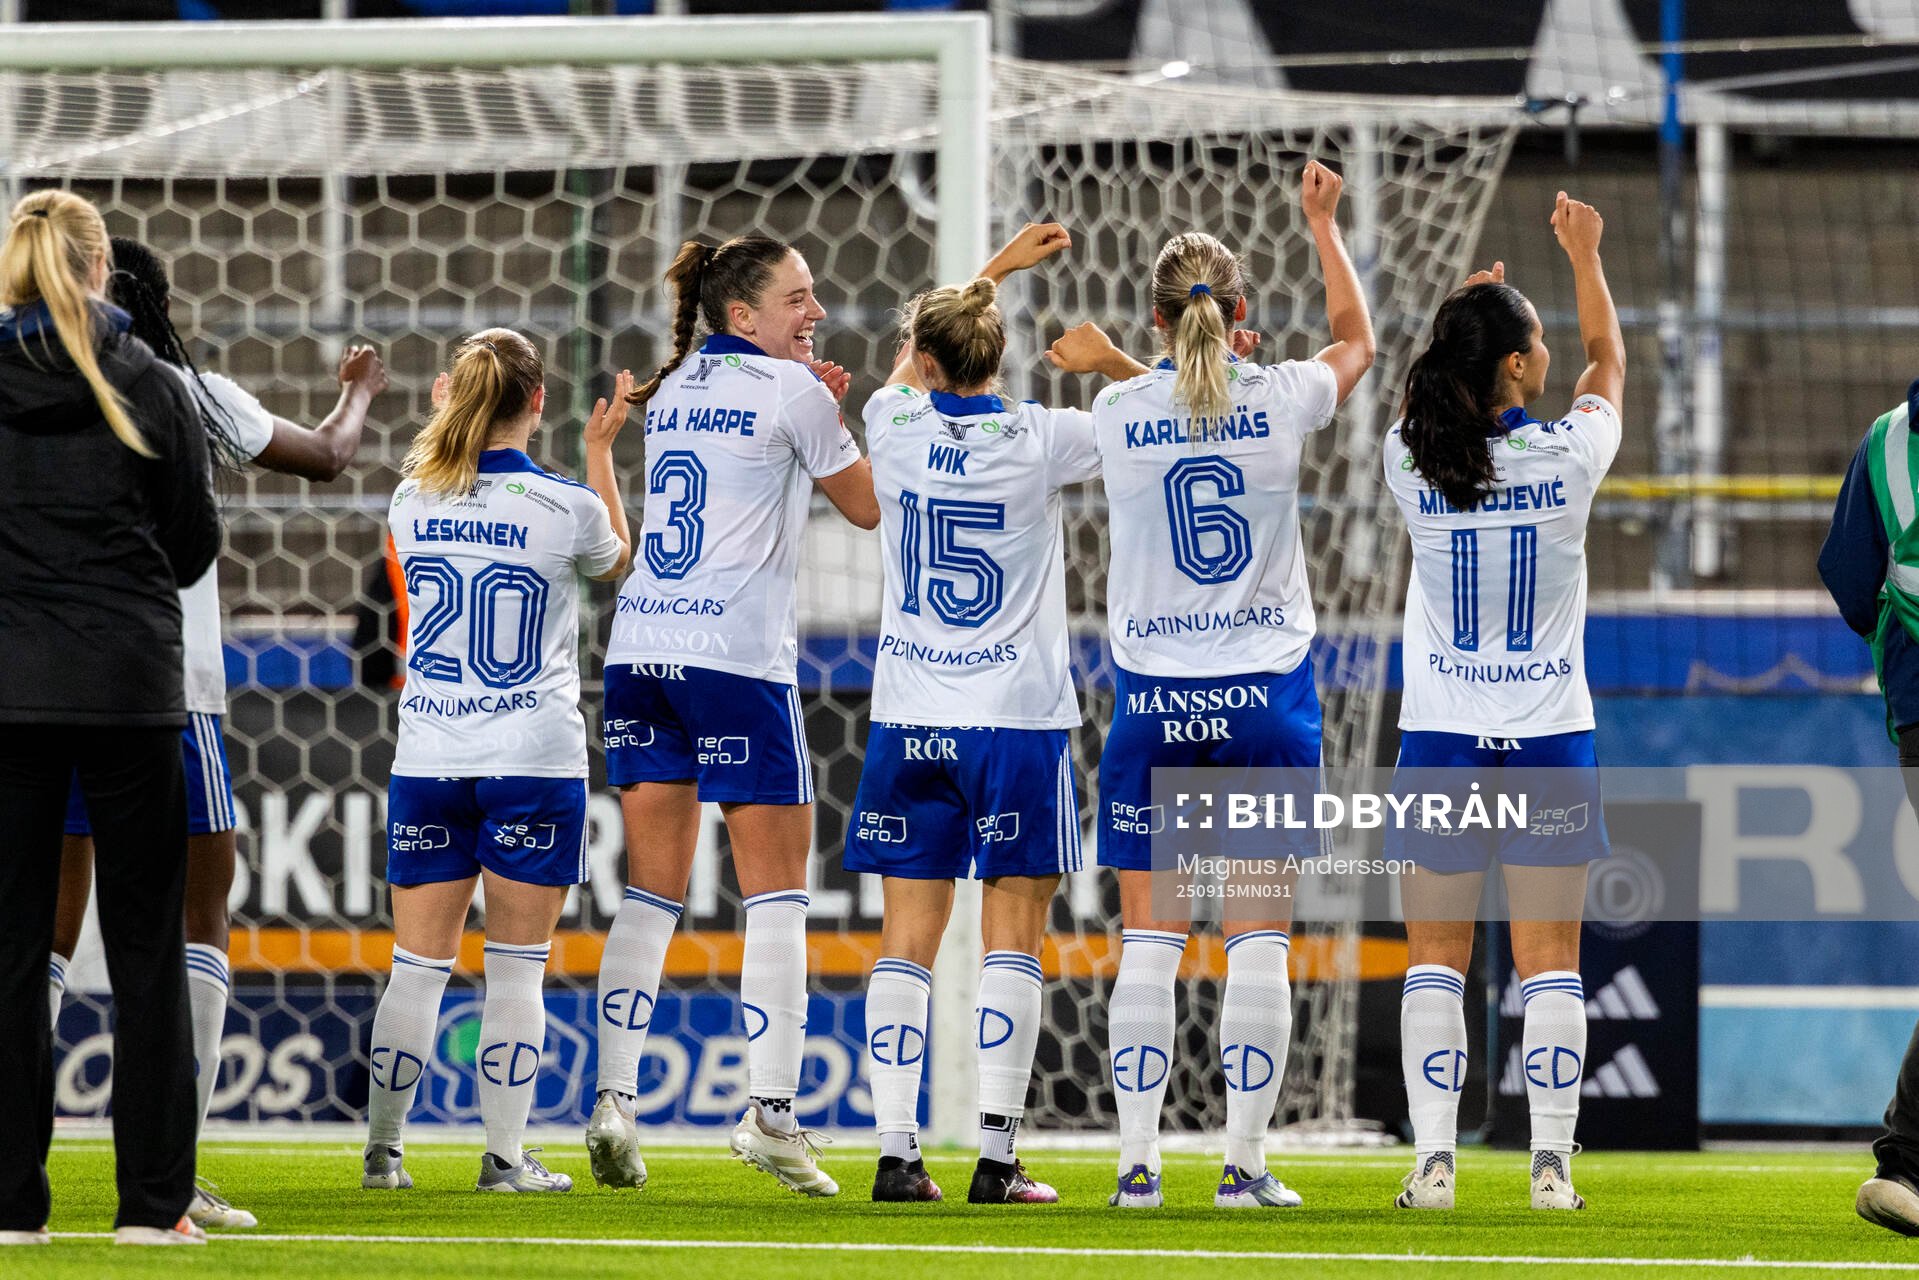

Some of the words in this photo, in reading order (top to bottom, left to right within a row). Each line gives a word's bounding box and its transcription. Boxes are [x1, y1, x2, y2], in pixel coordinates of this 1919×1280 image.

[657, 407, 679, 432] LA
[685, 408, 758, 437] HARPE
[928, 443, 970, 477] WIK
[1418, 474, 1566, 515] MILOJEVIĆ
[644, 450, 708, 580] 3
[1163, 455, 1253, 586] 6
[413, 518, 529, 550] LESKINEN
[899, 489, 1006, 629] 15
[1450, 526, 1537, 652] 11
[616, 595, 726, 616] TINUMCARS
[403, 556, 550, 690] 20
[1126, 607, 1285, 638] PLATINUMCARS
[880, 635, 1018, 666] PLINUMCARS
[1429, 654, 1571, 683] PLTINUMCA
[1126, 686, 1269, 715] MÅNSSON
[697, 737, 718, 748] re
[1161, 714, 1233, 744] RÖR
[697, 753, 732, 764] ero
[903, 732, 959, 761] RÖR
[859, 812, 880, 825] re
[1112, 801, 1136, 817] pre
[1530, 808, 1564, 822] pre
[393, 822, 419, 837] pre
[856, 826, 891, 842] ero
[1112, 818, 1149, 834] zero
[1529, 822, 1575, 836] zero
[392, 838, 433, 851] zero
[602, 988, 654, 1031] ED
[871, 1024, 925, 1067] ED
[371, 1047, 424, 1092] ED
[481, 1042, 540, 1087] ED
[1114, 1045, 1169, 1093] ED
[1222, 1044, 1275, 1092] ED
[1525, 1046, 1582, 1089] ED
